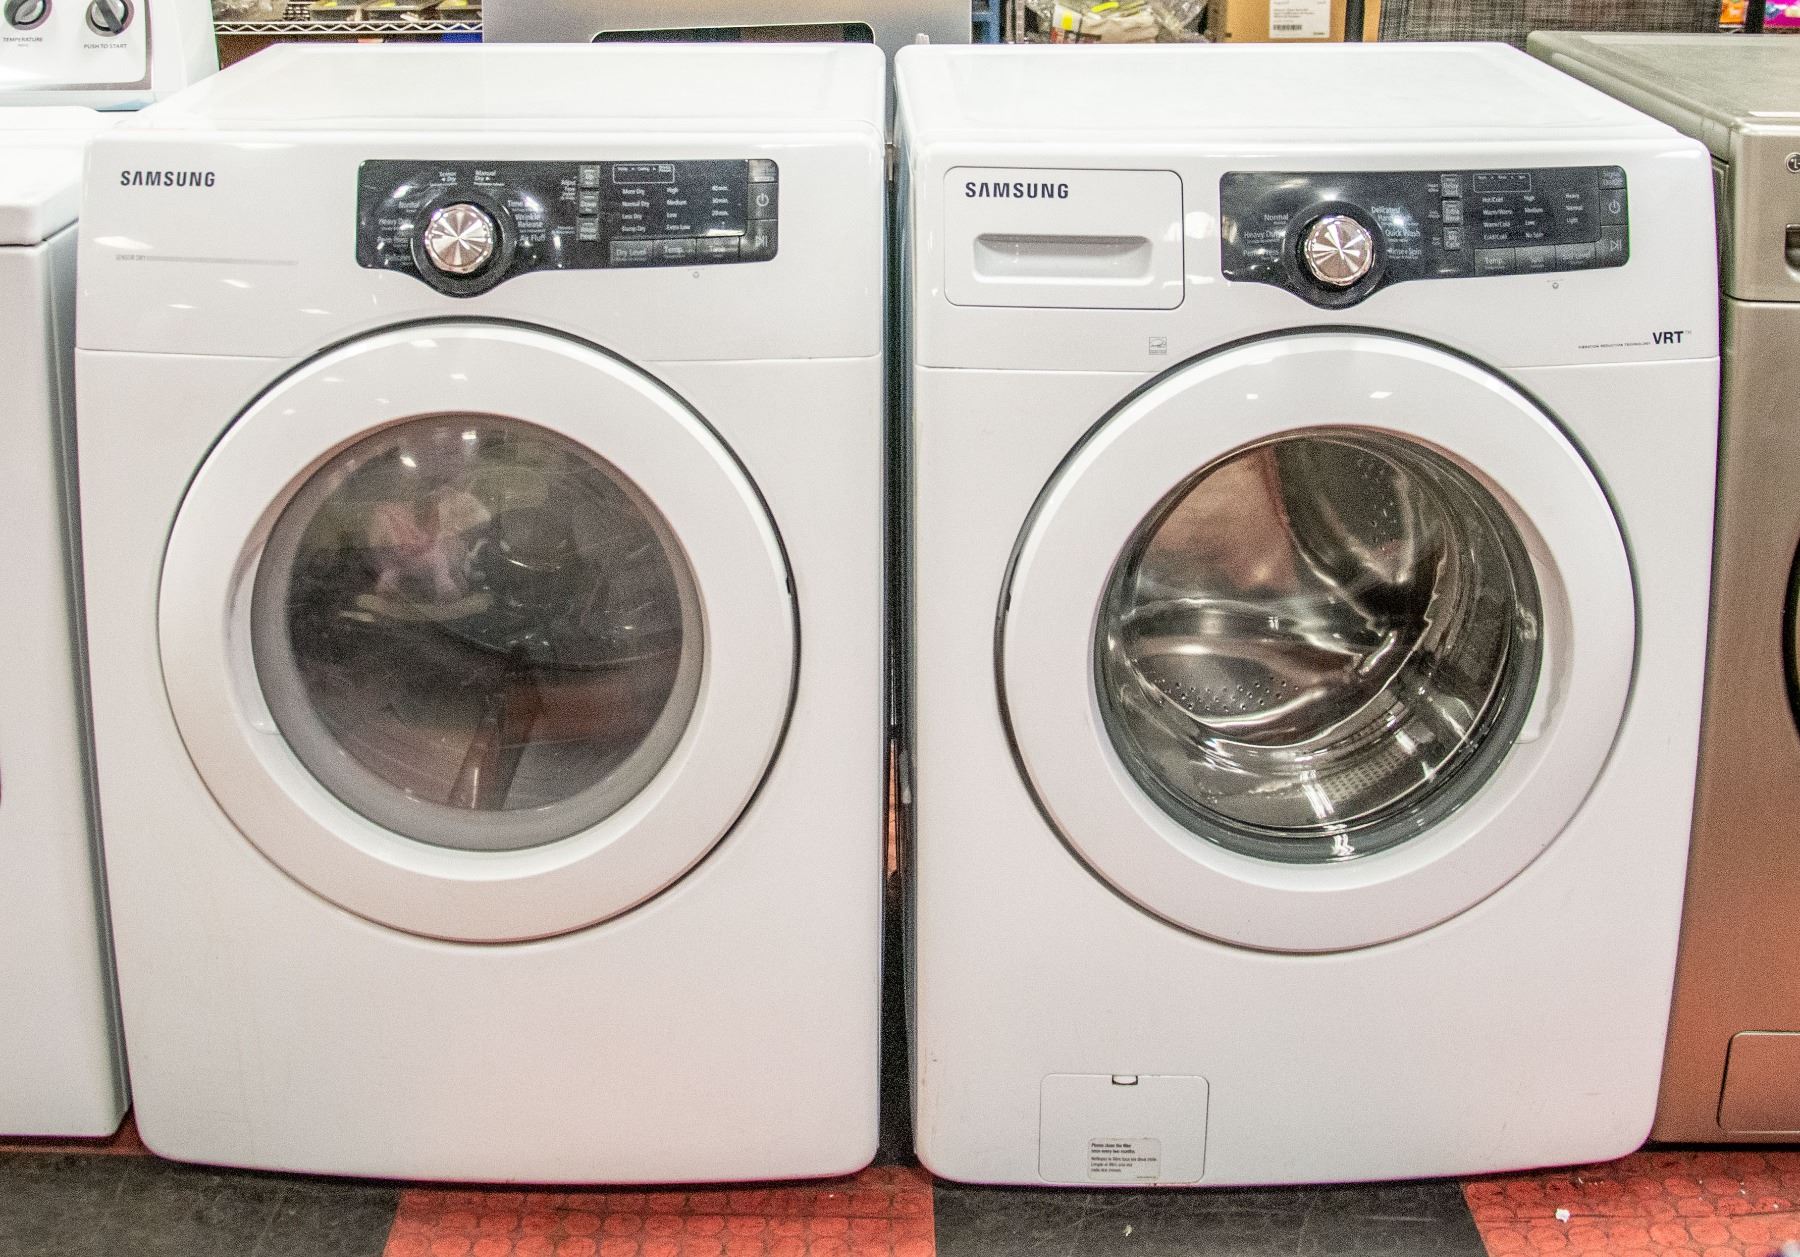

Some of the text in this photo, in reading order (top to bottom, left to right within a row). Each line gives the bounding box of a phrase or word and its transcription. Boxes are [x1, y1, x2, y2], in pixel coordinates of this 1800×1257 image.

[120, 170, 215, 187] SAMSUNG
[964, 182, 1069, 199] SAMSUNG
[1652, 331, 1684, 344] VRT
